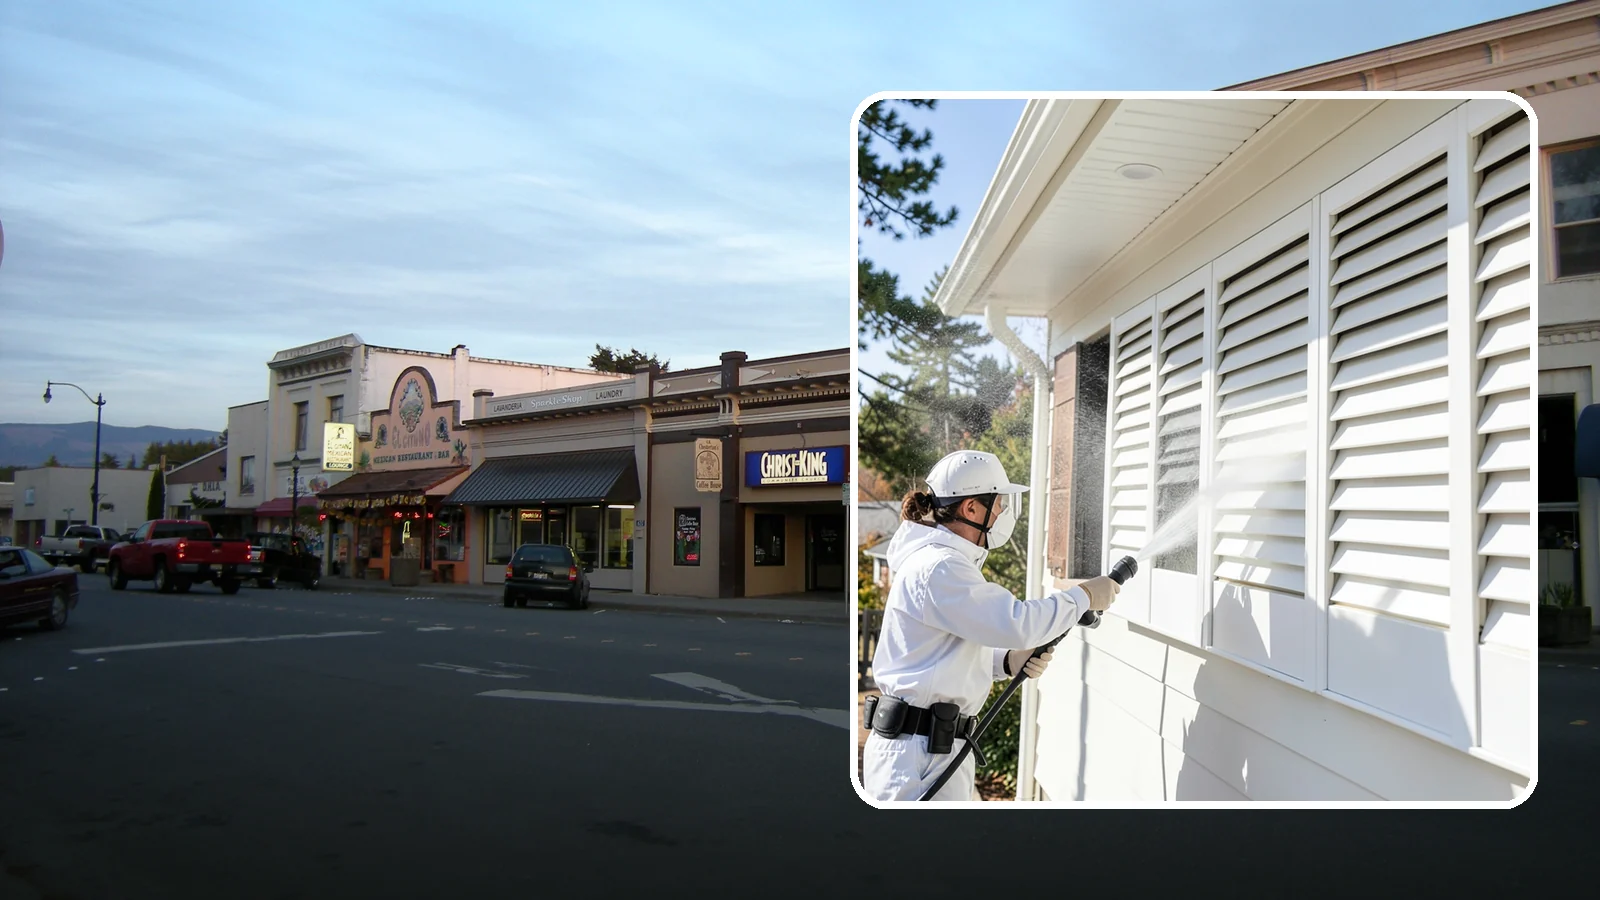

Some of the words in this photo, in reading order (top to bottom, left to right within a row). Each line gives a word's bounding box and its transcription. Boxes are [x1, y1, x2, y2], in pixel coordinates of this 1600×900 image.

[595, 389, 624, 400] LAUNDRY
[493, 402, 523, 412] LAVANDERIA
[531, 398, 561, 408] Sparkle
[562, 394, 582, 405] Shop
[373, 455, 396, 464] MEXICAN
[397, 451, 433, 462] RESTAURANT
[437, 450, 450, 459] BAR
[760, 452, 797, 478] CHRIST
[799, 449, 827, 477] KING
[696, 481, 709, 489] Coffee
[710, 481, 722, 489] House
